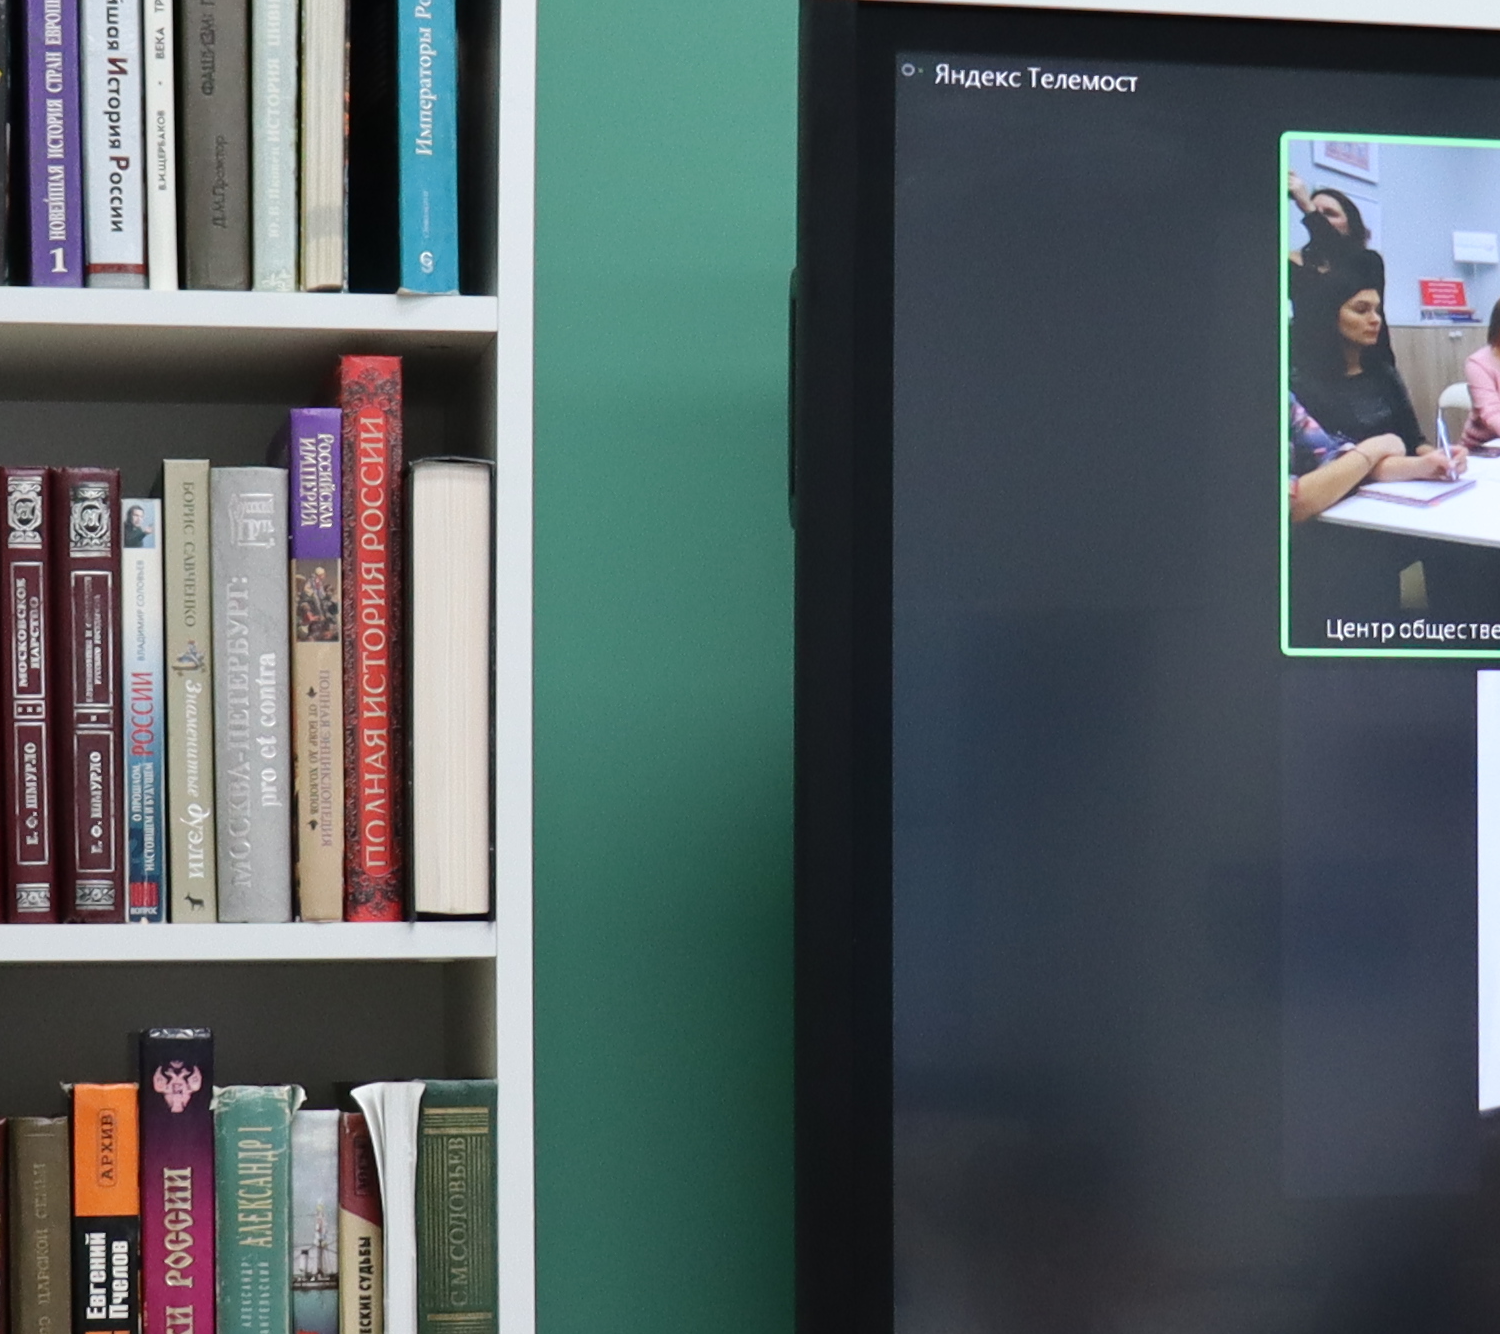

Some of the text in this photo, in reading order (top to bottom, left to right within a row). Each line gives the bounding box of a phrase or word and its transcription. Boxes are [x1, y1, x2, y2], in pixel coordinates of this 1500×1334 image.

[414, 27, 437, 156] Императоры
[934, 63, 1138, 93] Яндекс Телемост
[360, 416, 389, 868] ПОЛНАЯ ИСТОРИЯ РОССИИ
[1326, 618, 1395, 643] Центр
[162, 1167, 194, 1287] РОССИИ
